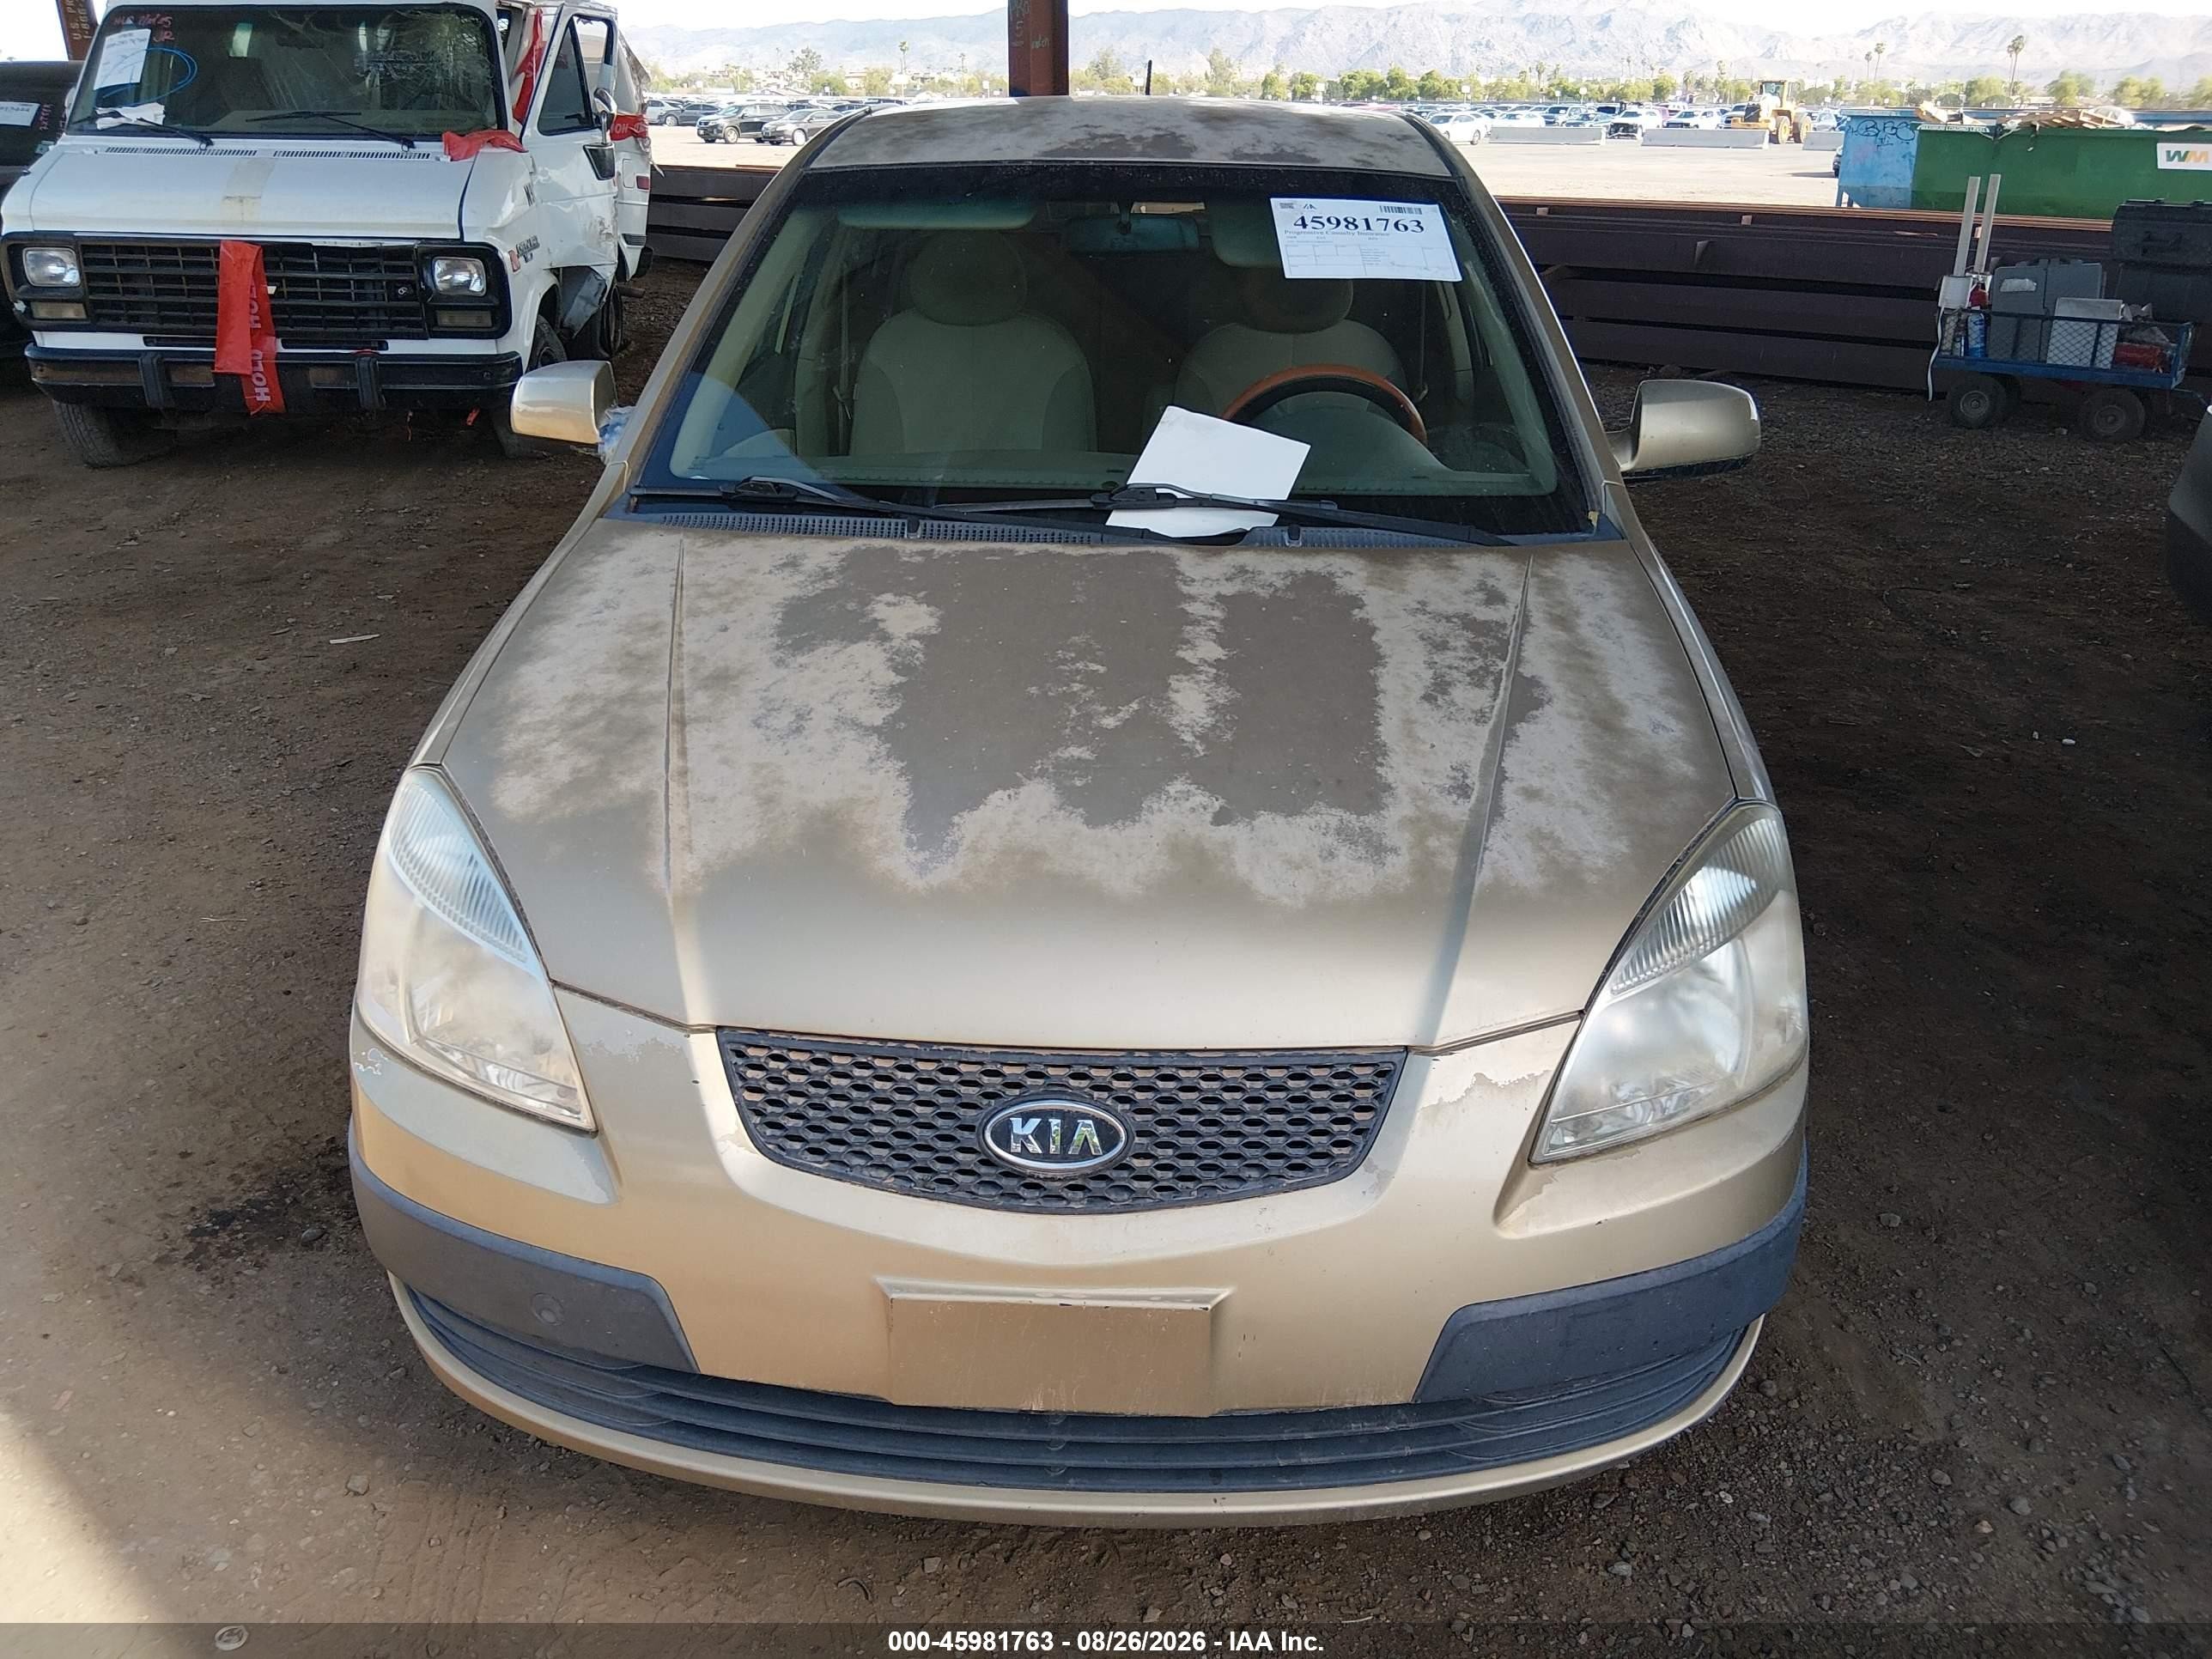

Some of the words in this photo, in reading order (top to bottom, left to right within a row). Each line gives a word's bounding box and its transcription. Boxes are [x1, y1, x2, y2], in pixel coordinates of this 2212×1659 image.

[2166, 150, 2209, 162] WM
[1293, 215, 1425, 234] 45981763
[1009, 1117, 1103, 1155] KIA
